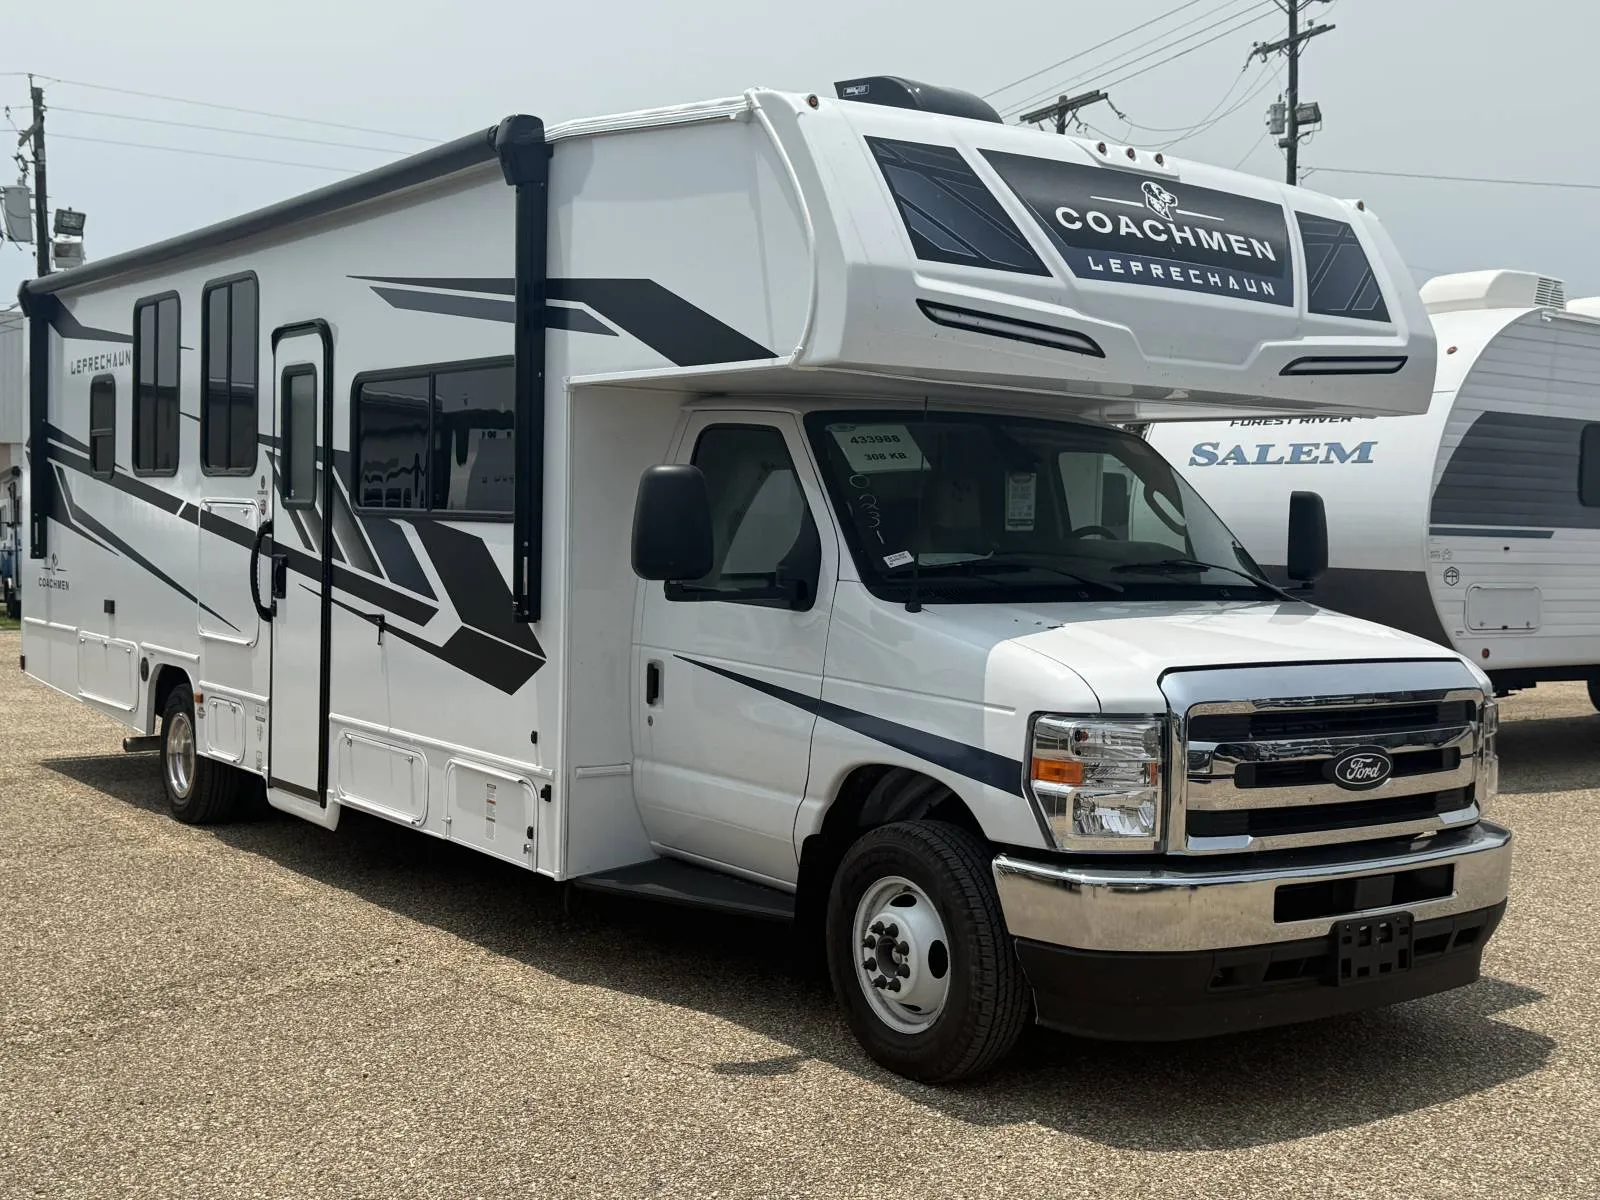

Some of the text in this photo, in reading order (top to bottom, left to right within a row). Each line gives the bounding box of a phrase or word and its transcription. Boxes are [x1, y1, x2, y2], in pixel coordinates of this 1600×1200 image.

[1055, 206, 1277, 262] COACHMEN
[1087, 255, 1276, 297] LEPRECHAUN
[70, 349, 131, 376] LEPRECHAUN
[1188, 441, 1379, 467] SALEM
[1346, 757, 1381, 780] Ford
